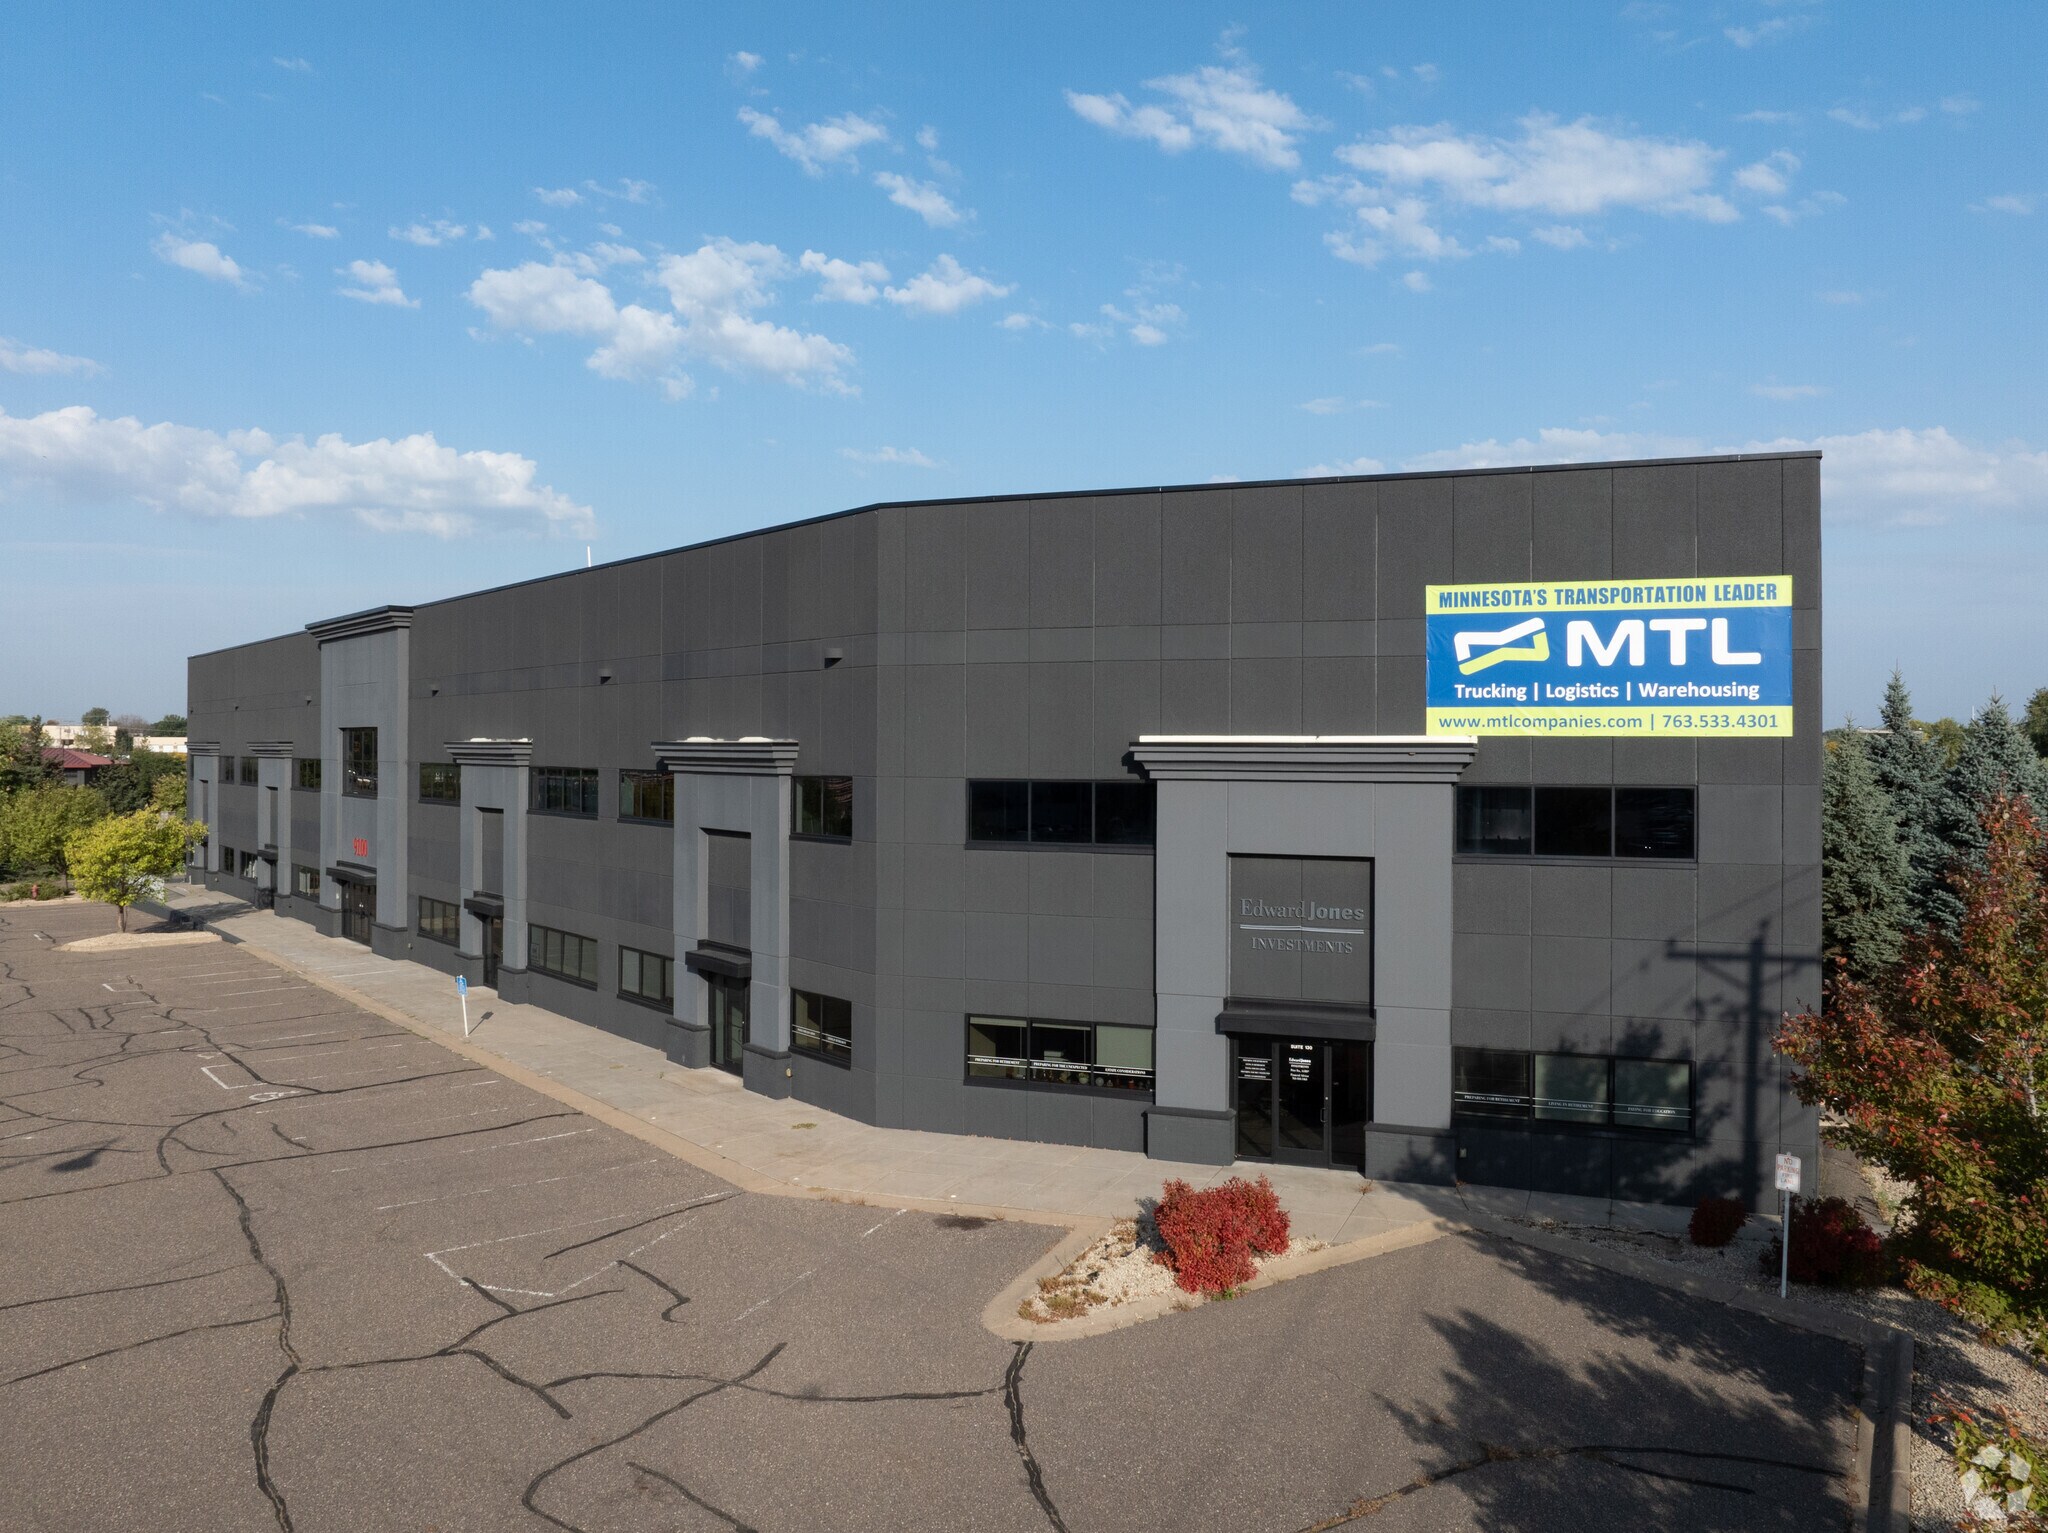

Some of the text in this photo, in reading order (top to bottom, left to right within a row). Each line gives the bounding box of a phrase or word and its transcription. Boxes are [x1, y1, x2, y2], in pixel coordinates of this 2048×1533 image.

[1439, 583, 1777, 608] MINNESOTA'S TRANSPORTATION LEADER
[1566, 617, 1762, 667] MTL
[1454, 682, 1760, 701] Trucking Logistics Warehousing
[1439, 714, 1778, 731] www.mtlcompanies.com 763.533.4301
[1252, 937, 1353, 954] INVESTMENTS
